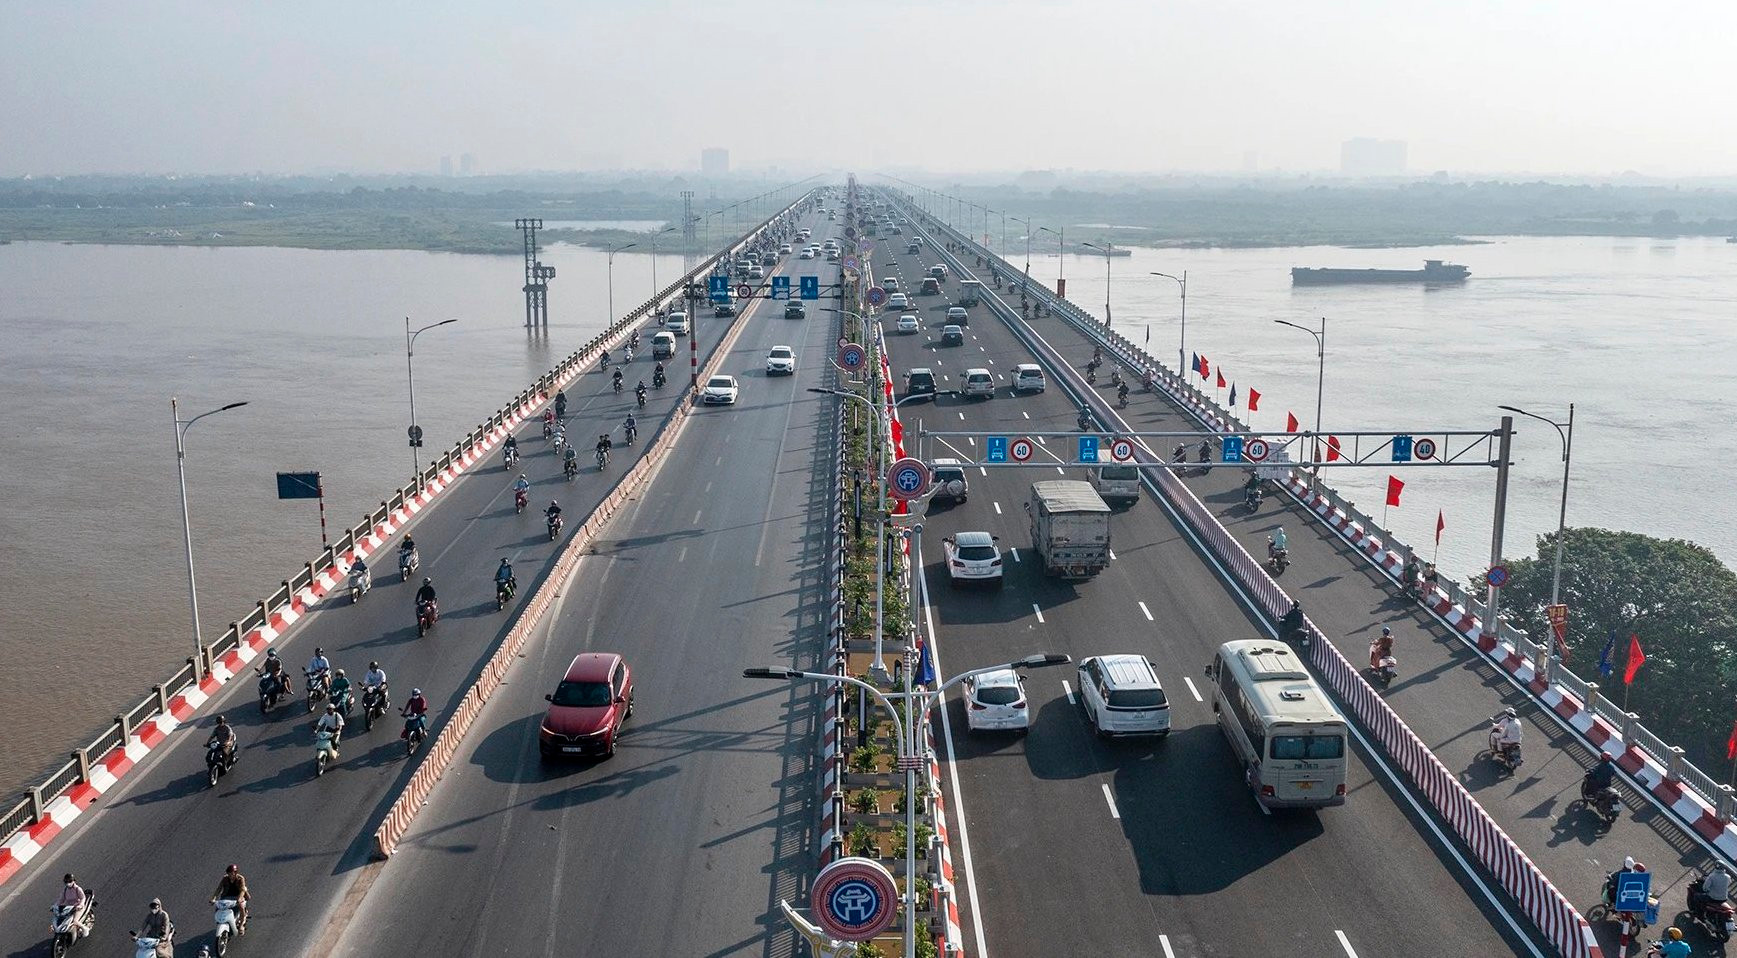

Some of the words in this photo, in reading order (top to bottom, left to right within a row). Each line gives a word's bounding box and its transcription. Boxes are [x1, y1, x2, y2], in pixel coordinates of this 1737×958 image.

[1017, 446, 1027, 455] 60
[1118, 446, 1127, 455] 60
[1253, 446, 1262, 454] 60
[1420, 445, 1430, 454] 40
